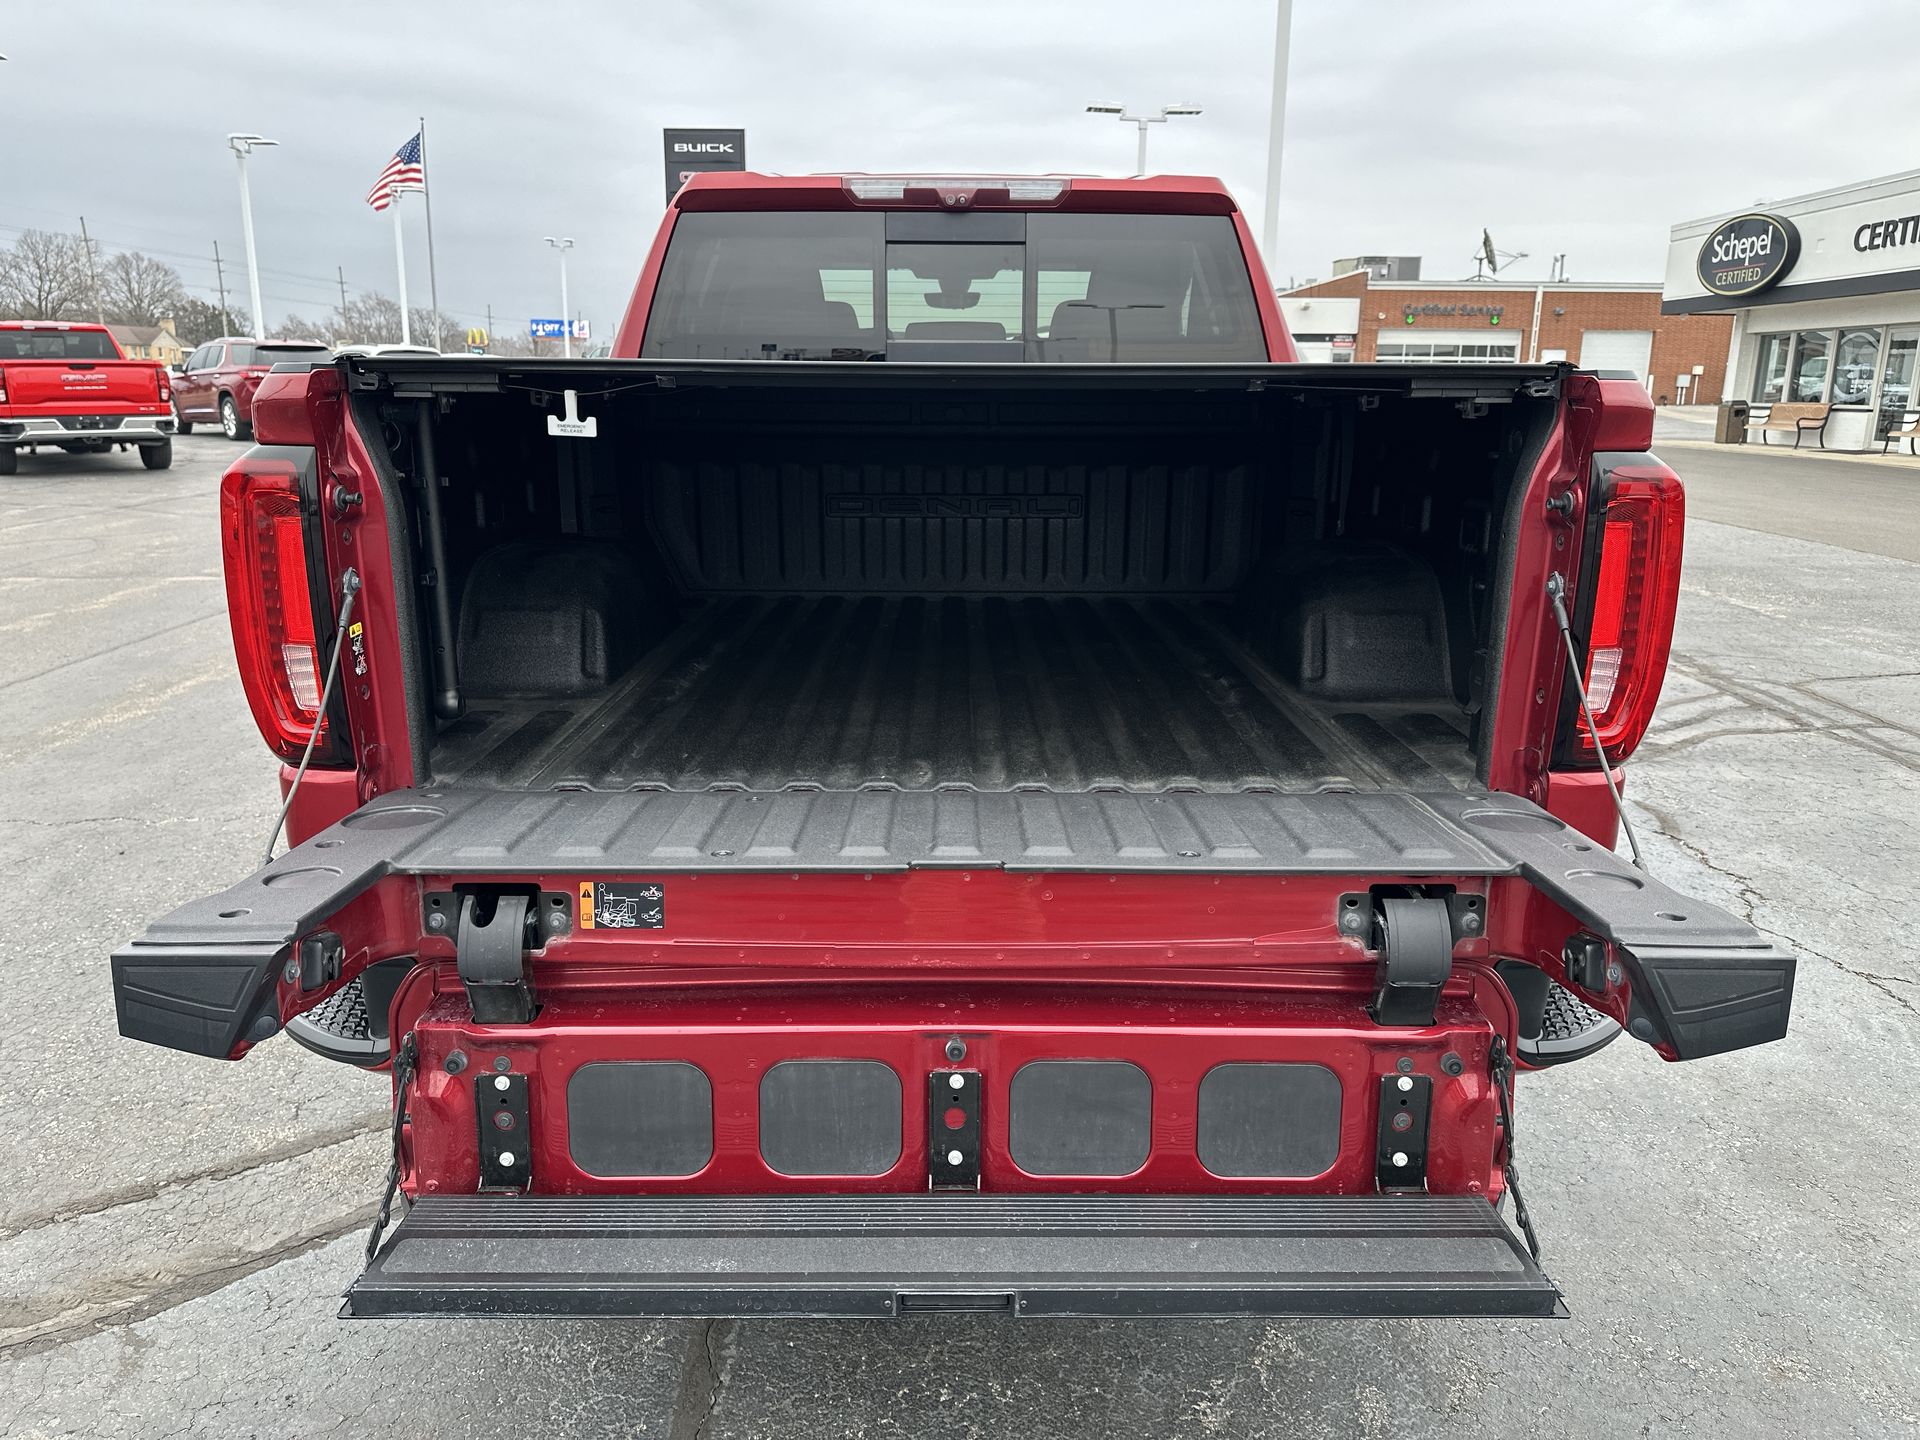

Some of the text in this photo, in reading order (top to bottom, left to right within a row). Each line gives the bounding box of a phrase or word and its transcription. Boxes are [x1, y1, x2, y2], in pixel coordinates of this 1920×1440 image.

[674, 143, 734, 152] BUICK
[1854, 215, 1920, 252] CERTI
[1711, 225, 1773, 266] Schepel
[1715, 267, 1761, 286] CERTIFIED
[828, 497, 1080, 515] DENALI
